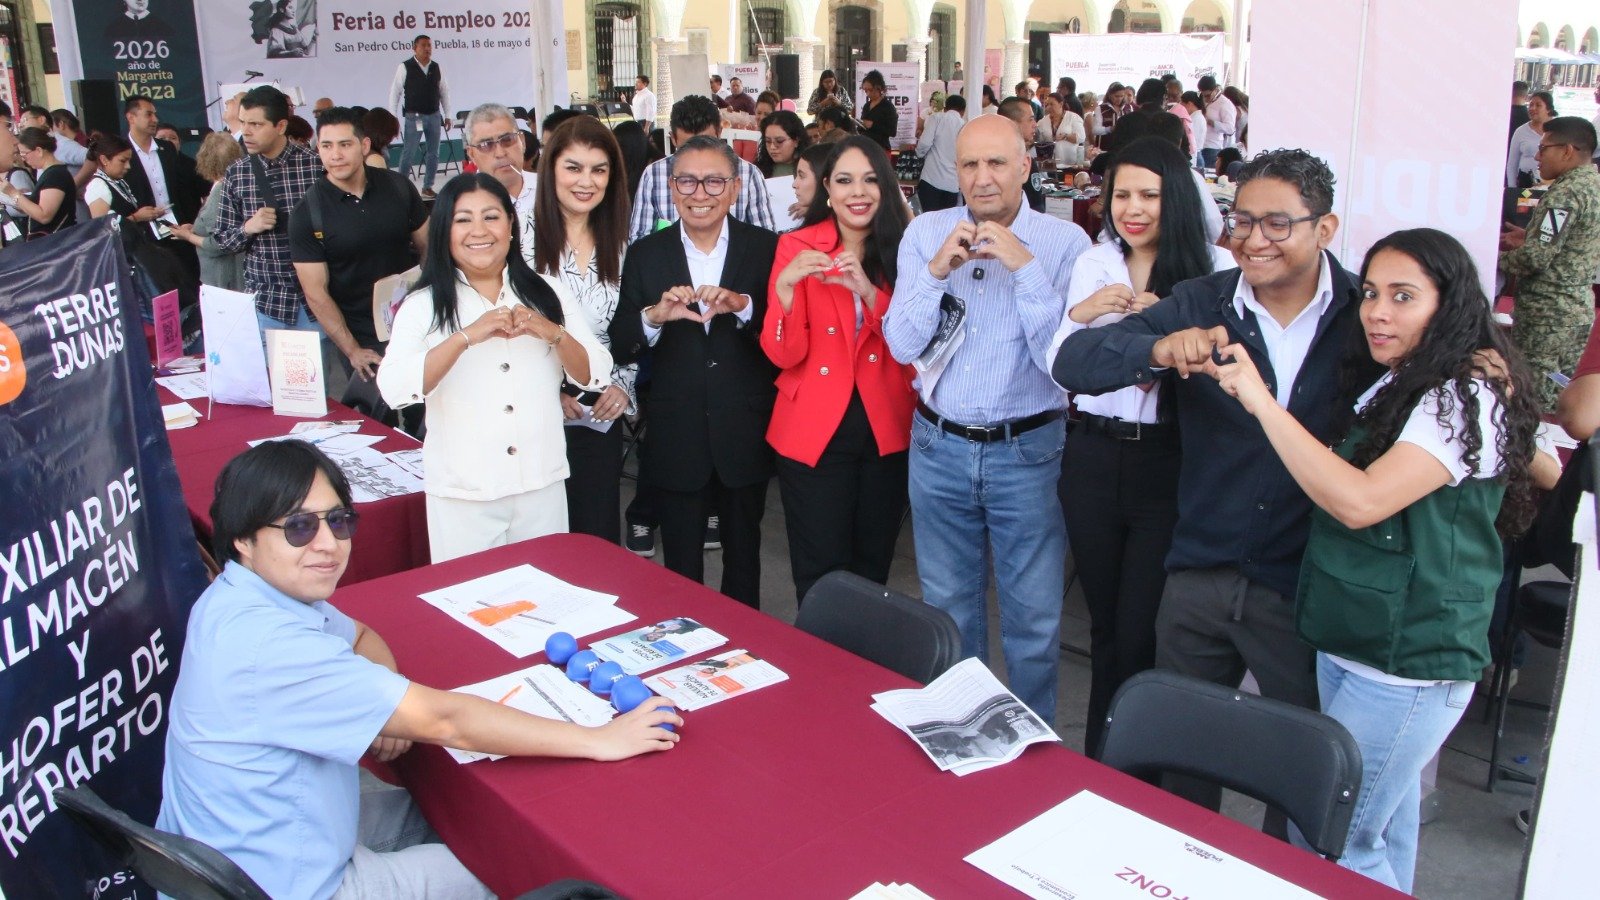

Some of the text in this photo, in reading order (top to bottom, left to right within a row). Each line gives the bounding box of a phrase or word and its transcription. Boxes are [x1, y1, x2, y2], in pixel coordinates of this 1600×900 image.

[332, 10, 531, 32] Feria de Empleo 202
[113, 40, 170, 60] 2026
[334, 38, 531, 53] San Pedro Chol Puebla, 18 de mayo d
[117, 70, 173, 84] Margarita
[127, 60, 161, 70] año de
[1065, 61, 1089, 69] PUEBLA
[118, 82, 176, 102] Maza
[34, 282, 120, 340] FERRE
[51, 318, 124, 379] DUNAS
[0, 467, 141, 604] XILIAR DE
[0, 531, 139, 672] LMACÉN
[67, 629, 89, 680] Y
[0, 628, 169, 797] HOFER DE
[0, 692, 162, 858] REPARTO
